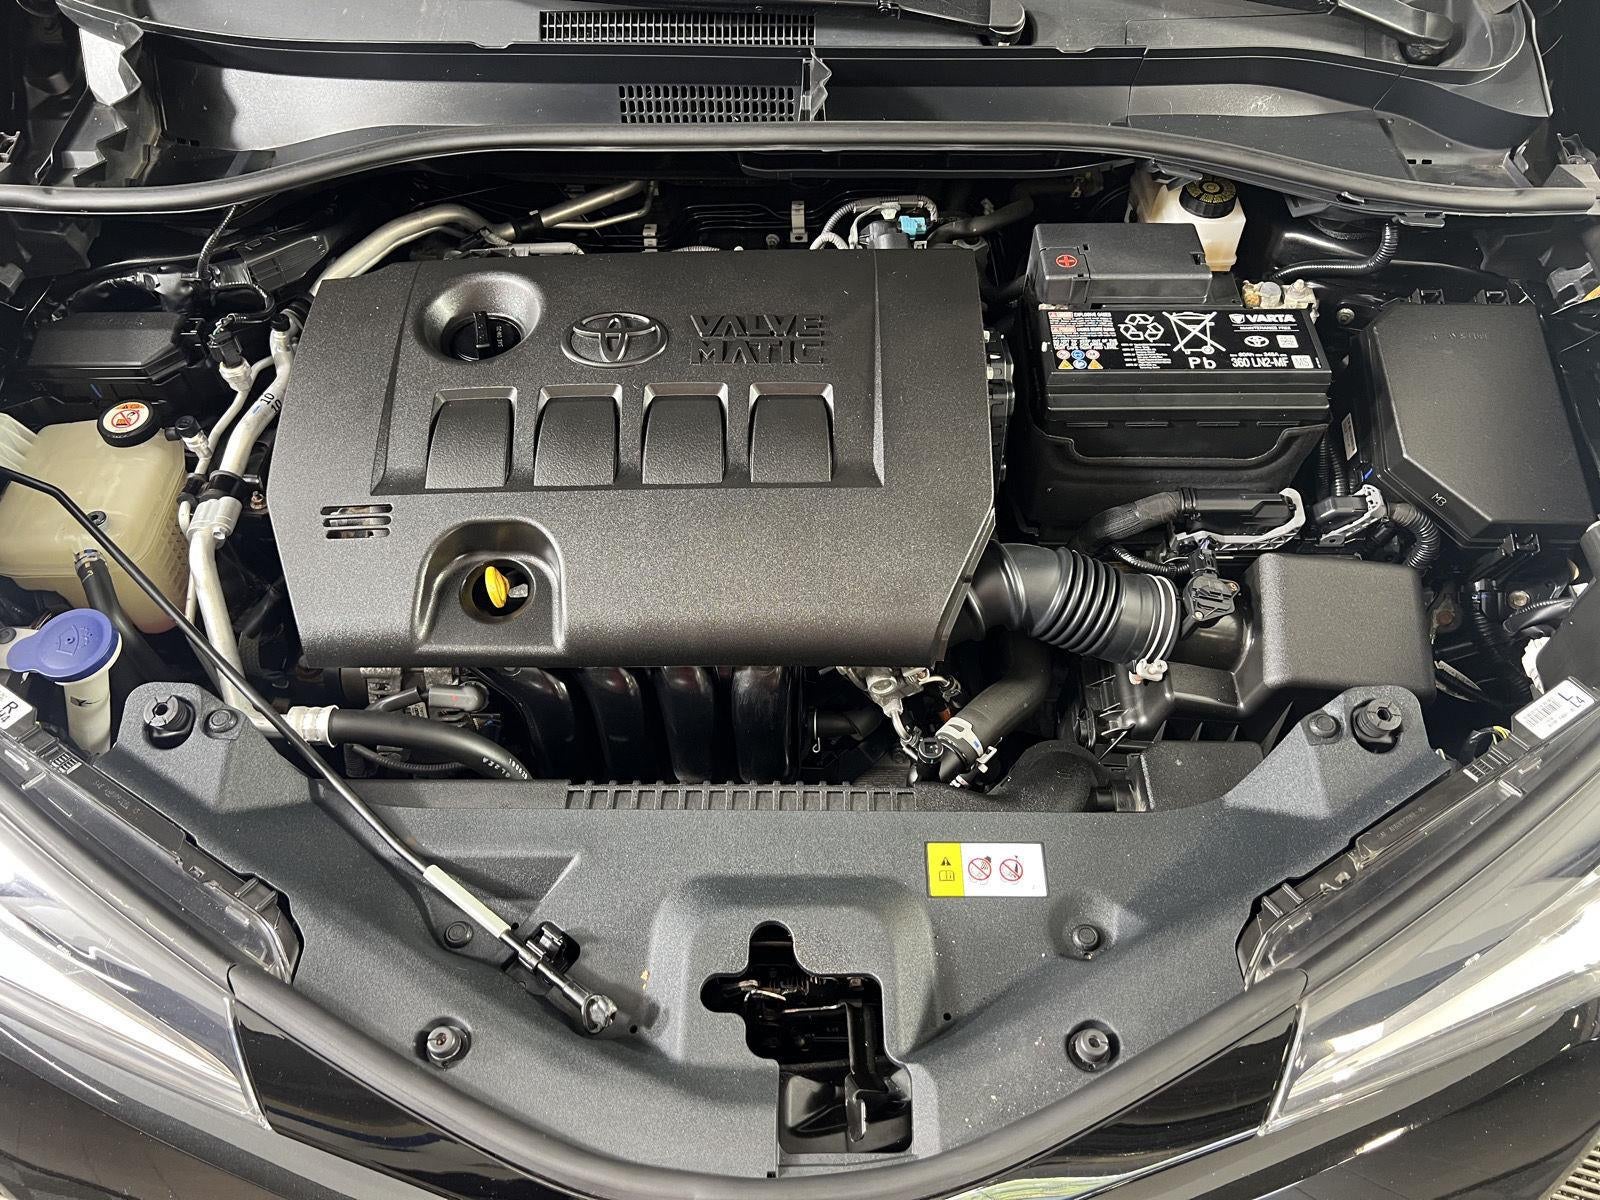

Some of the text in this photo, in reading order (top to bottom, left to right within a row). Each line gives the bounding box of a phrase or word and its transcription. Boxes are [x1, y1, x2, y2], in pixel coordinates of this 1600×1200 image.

[1245, 314, 1296, 322] VARTA
[690, 314, 824, 337] VALVE
[689, 339, 824, 365] MATIC
[1188, 357, 1217, 369] Pb
[1230, 357, 1289, 367] 360 LN2-MF
[261, 393, 274, 405] 10
[1431, 492, 1447, 507] M3
[1557, 692, 1574, 702] L
[2, 701, 19, 714] R
